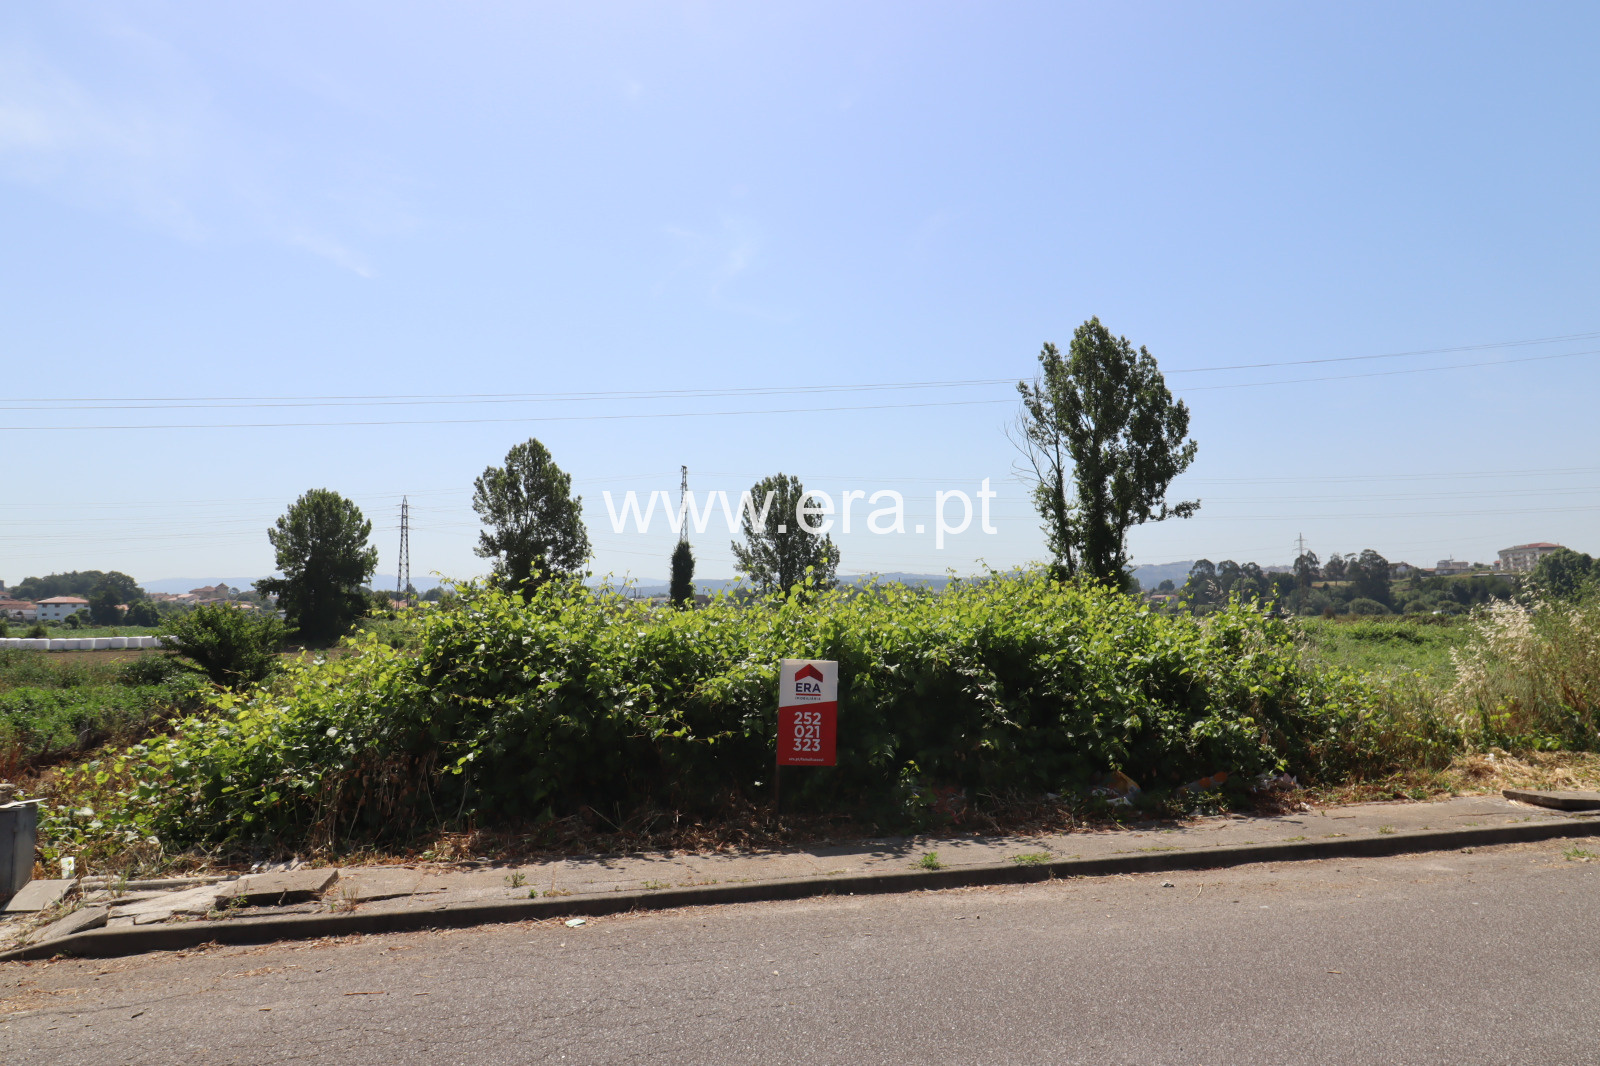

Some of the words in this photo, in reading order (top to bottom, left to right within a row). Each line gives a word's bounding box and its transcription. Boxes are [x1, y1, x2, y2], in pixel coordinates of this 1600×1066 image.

[796, 682, 821, 693] ERA
[794, 711, 822, 725] 252
[794, 725, 820, 738] 021
[793, 738, 821, 751] 323
